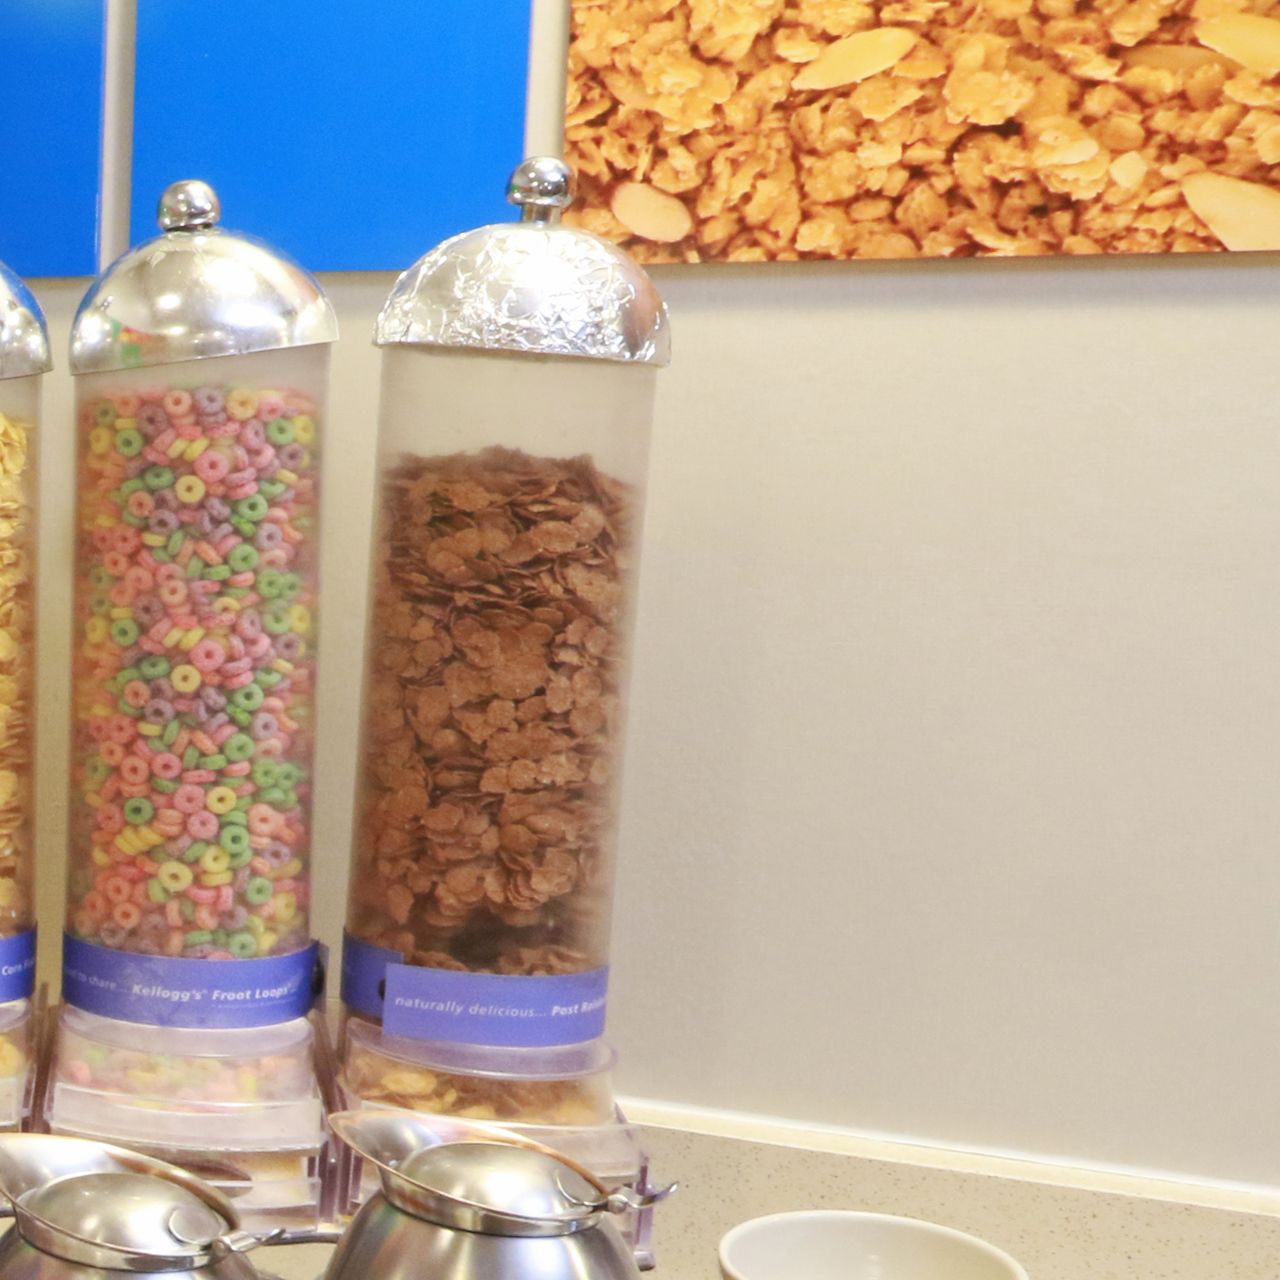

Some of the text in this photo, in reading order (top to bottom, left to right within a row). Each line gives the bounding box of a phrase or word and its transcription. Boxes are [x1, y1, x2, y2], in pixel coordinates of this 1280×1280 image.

[131, 982, 207, 1002] Kellogg's
[212, 988, 251, 1001] Froot
[395, 996, 464, 1016] naturally
